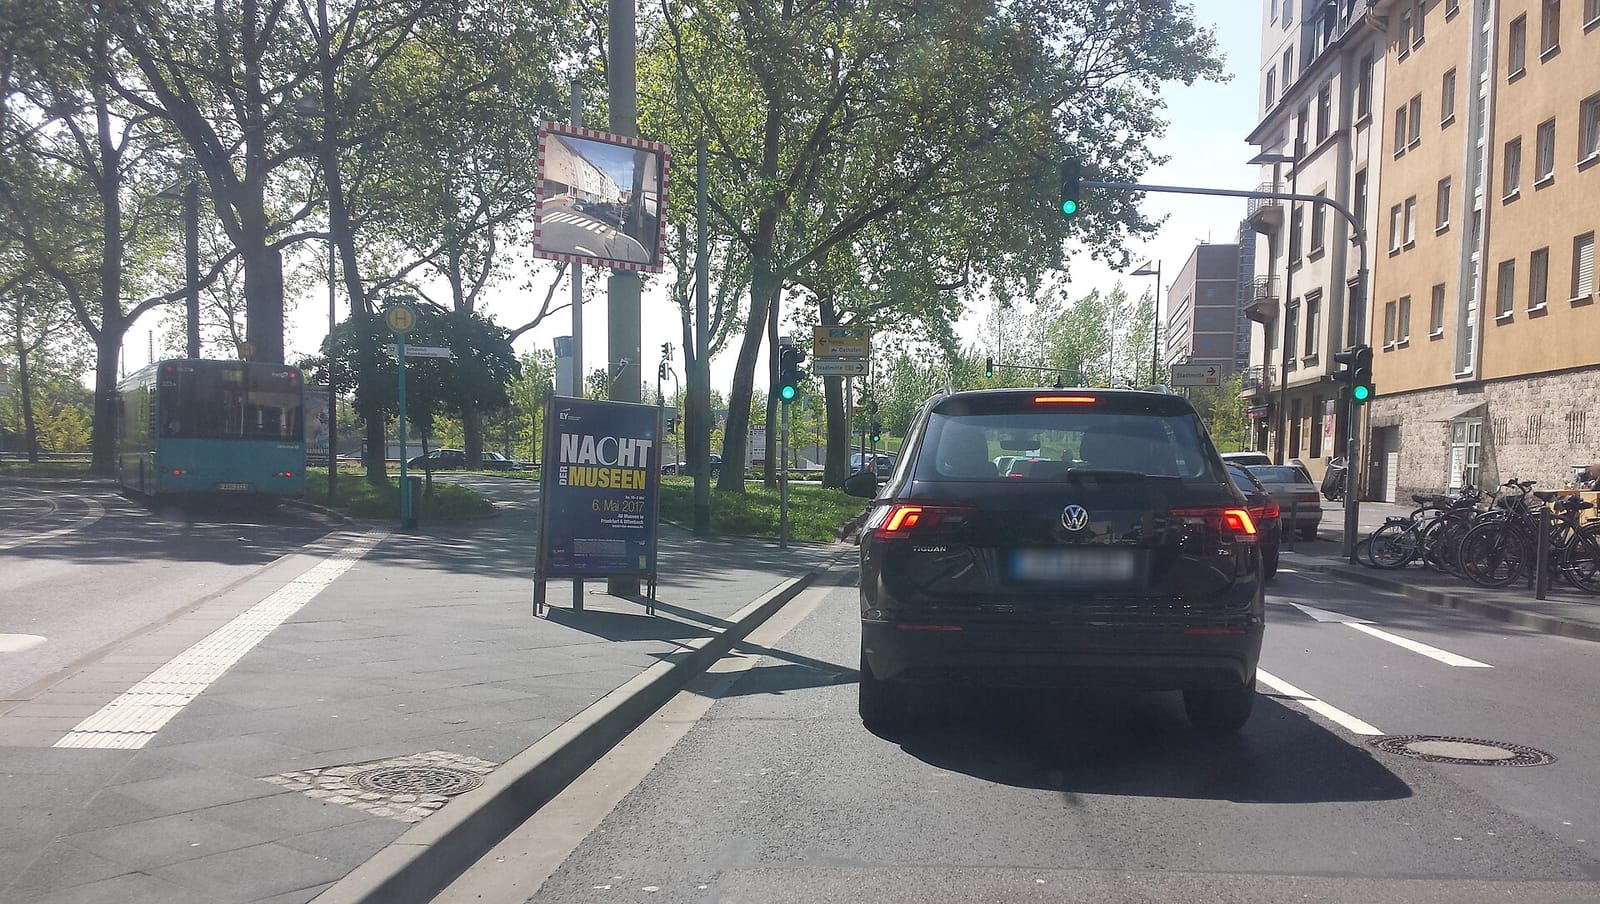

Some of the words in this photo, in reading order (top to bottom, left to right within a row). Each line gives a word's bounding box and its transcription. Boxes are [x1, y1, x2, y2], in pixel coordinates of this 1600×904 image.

[395, 310, 407, 327] H
[559, 412, 569, 420] EY
[560, 433, 653, 468] NACHT
[559, 465, 568, 486] DER
[568, 466, 646, 490] MUSEEN
[592, 499, 601, 511] 6.
[604, 499, 620, 512] Mai
[622, 500, 645, 513] 2017
